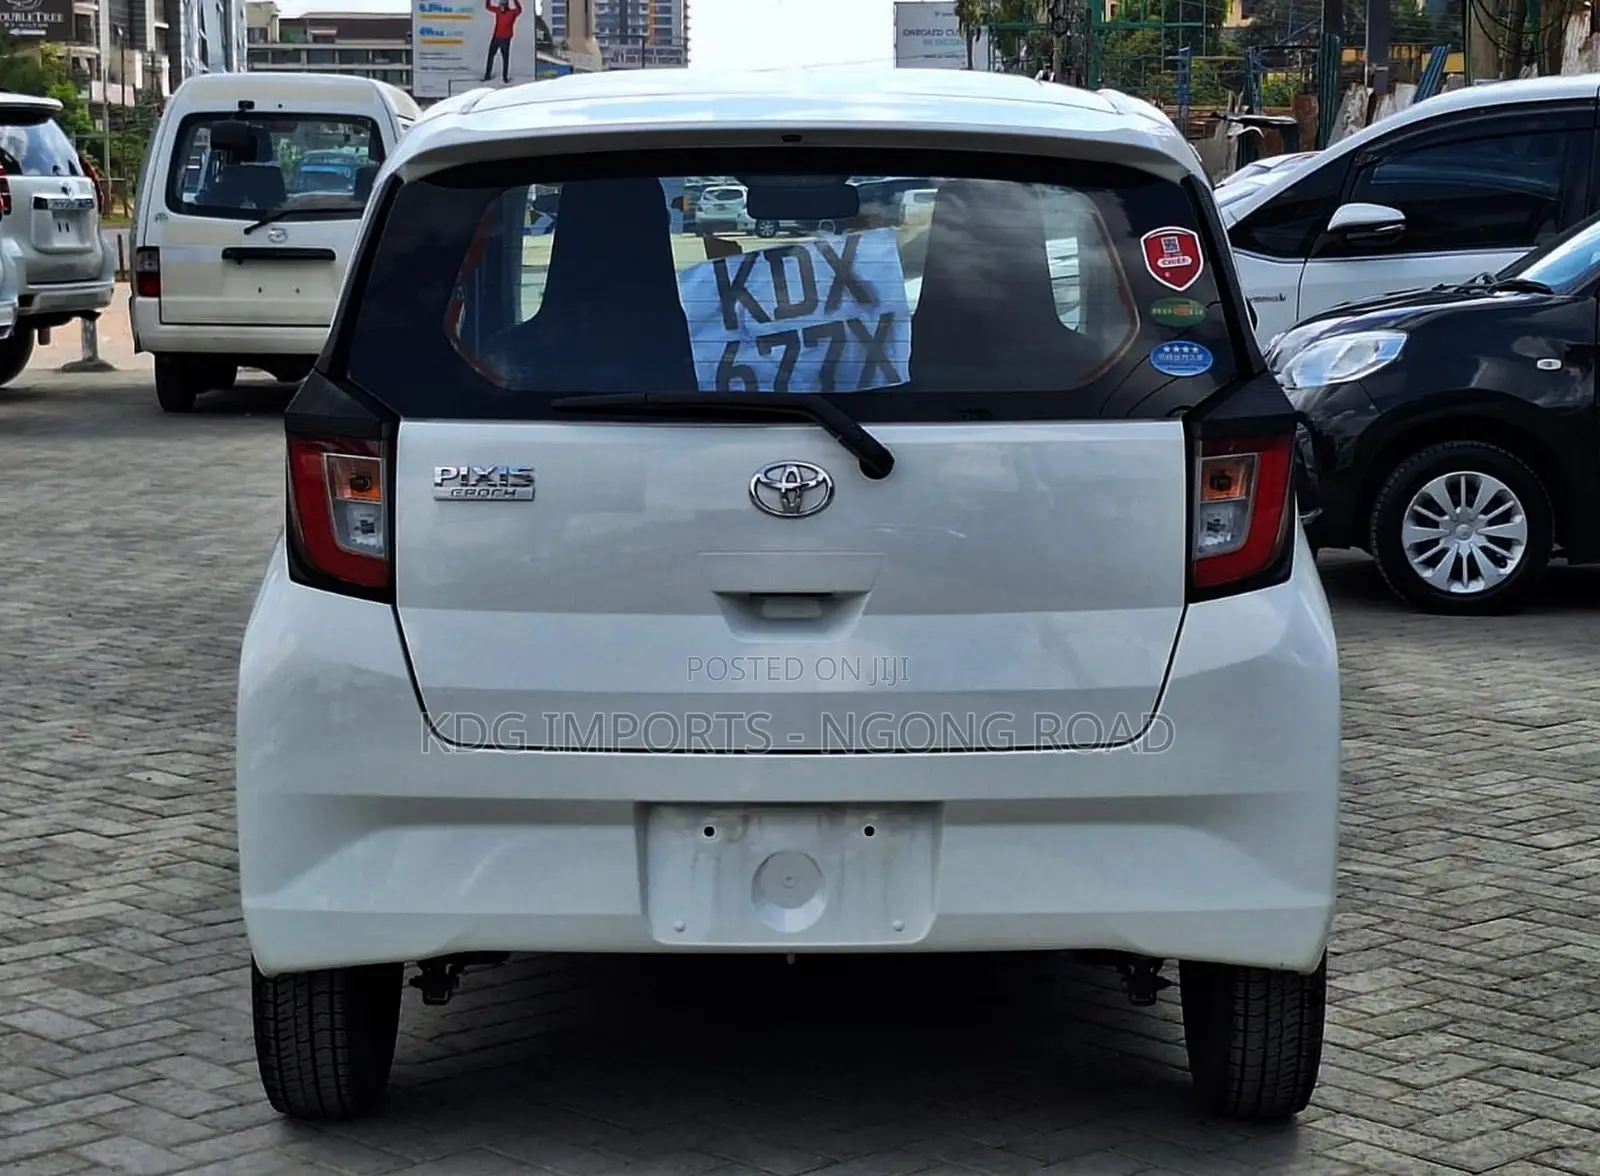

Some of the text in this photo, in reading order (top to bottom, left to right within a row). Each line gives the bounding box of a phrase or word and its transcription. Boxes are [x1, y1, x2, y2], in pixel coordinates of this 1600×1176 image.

[713, 235, 876, 331] KDX
[715, 311, 901, 392] 677X
[434, 466, 534, 487] PIXIS
[451, 488, 517, 498] EPOCH
